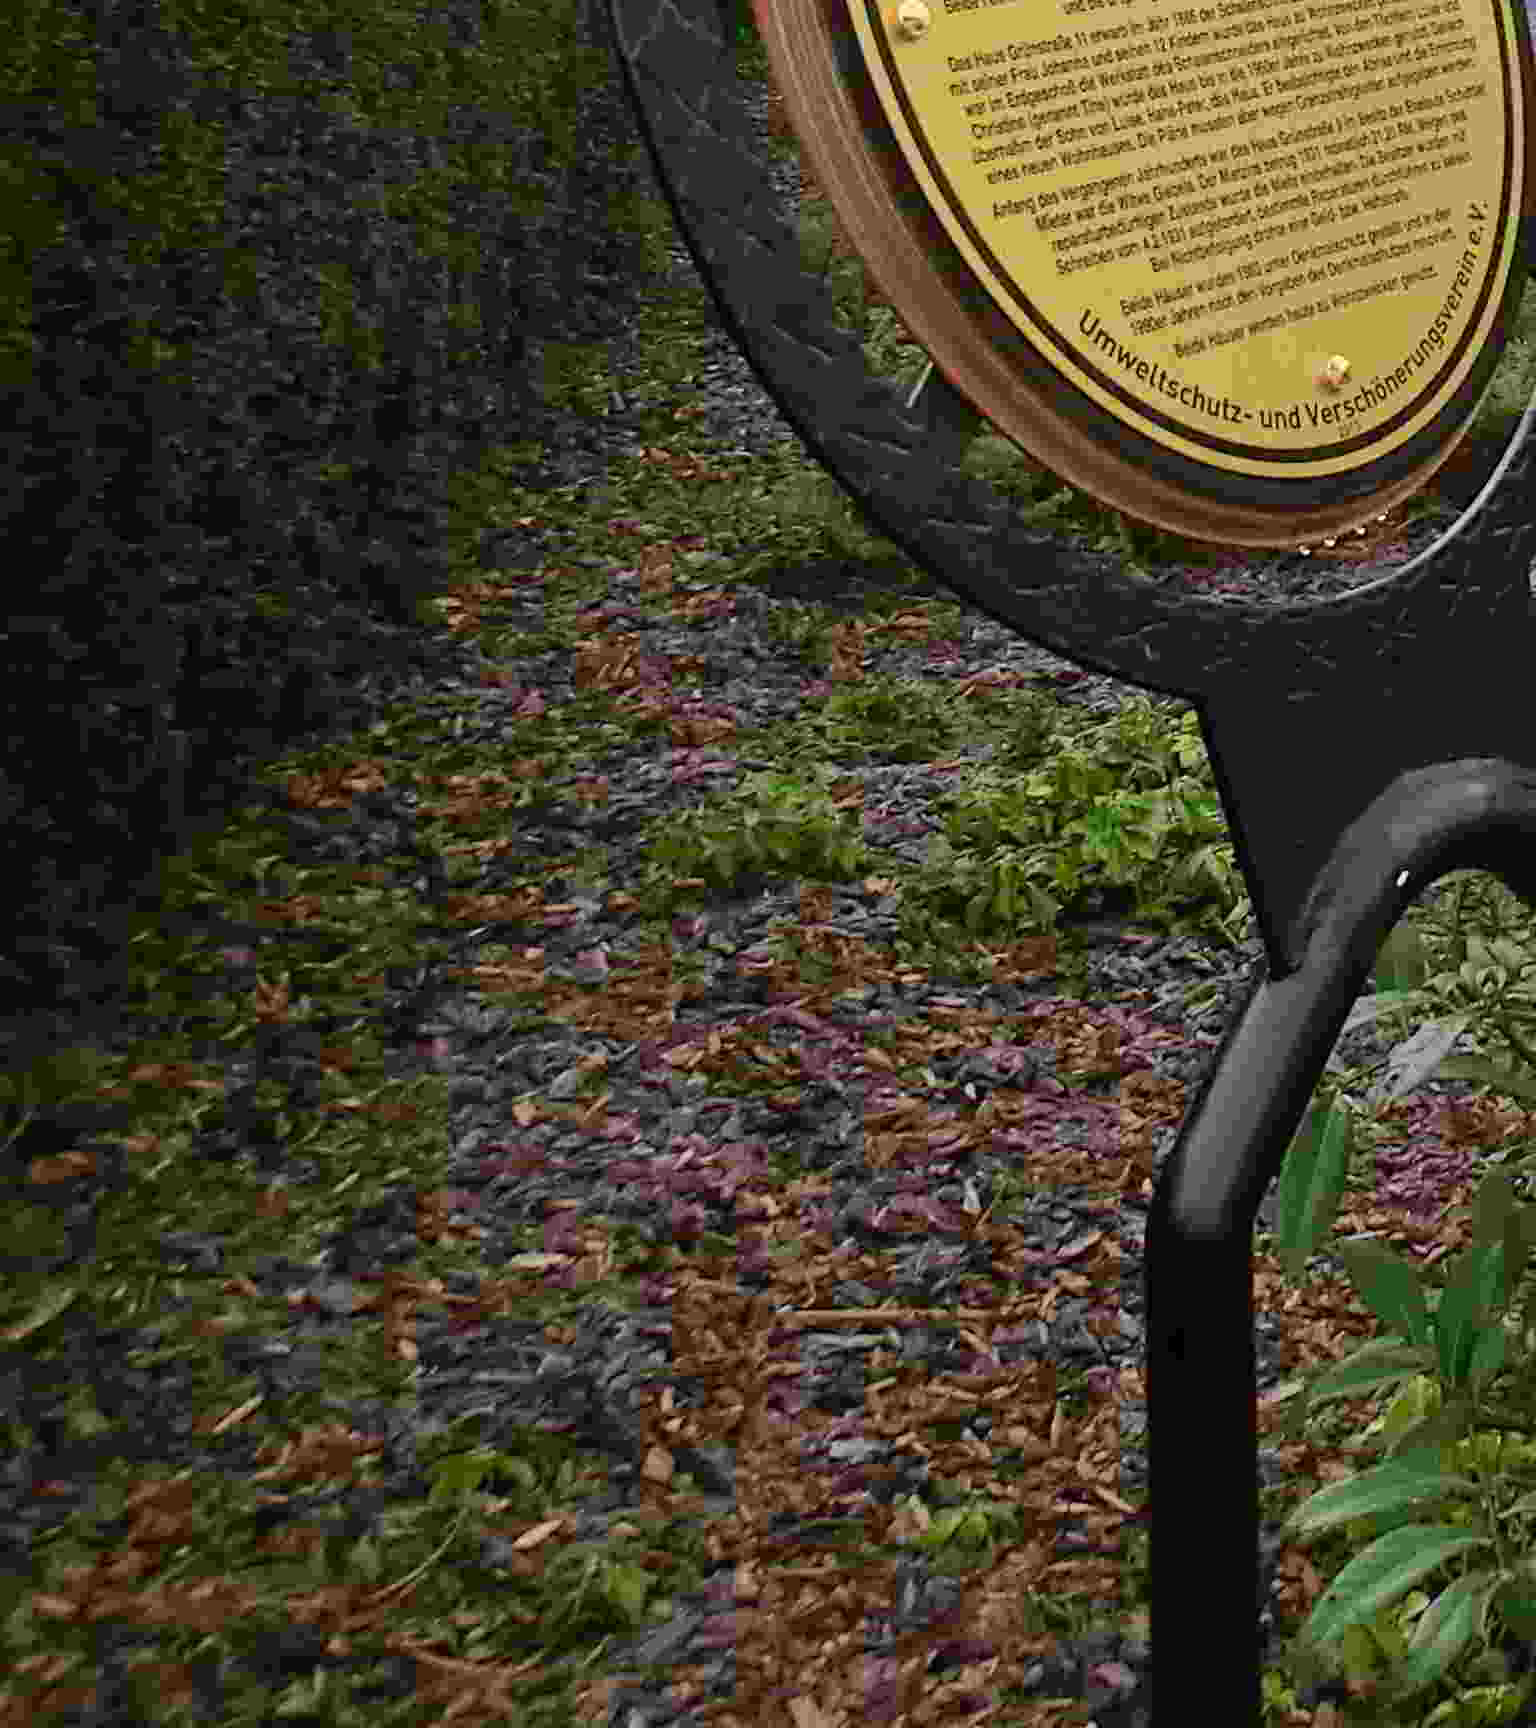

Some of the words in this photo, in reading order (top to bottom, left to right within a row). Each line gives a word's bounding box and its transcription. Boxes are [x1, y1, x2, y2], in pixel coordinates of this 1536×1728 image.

[1079, 308, 1252, 424] Umweltschutz-
[1261, 402, 1301, 432] und
[1305, 247, 1478, 428] Verschönerungsverein
